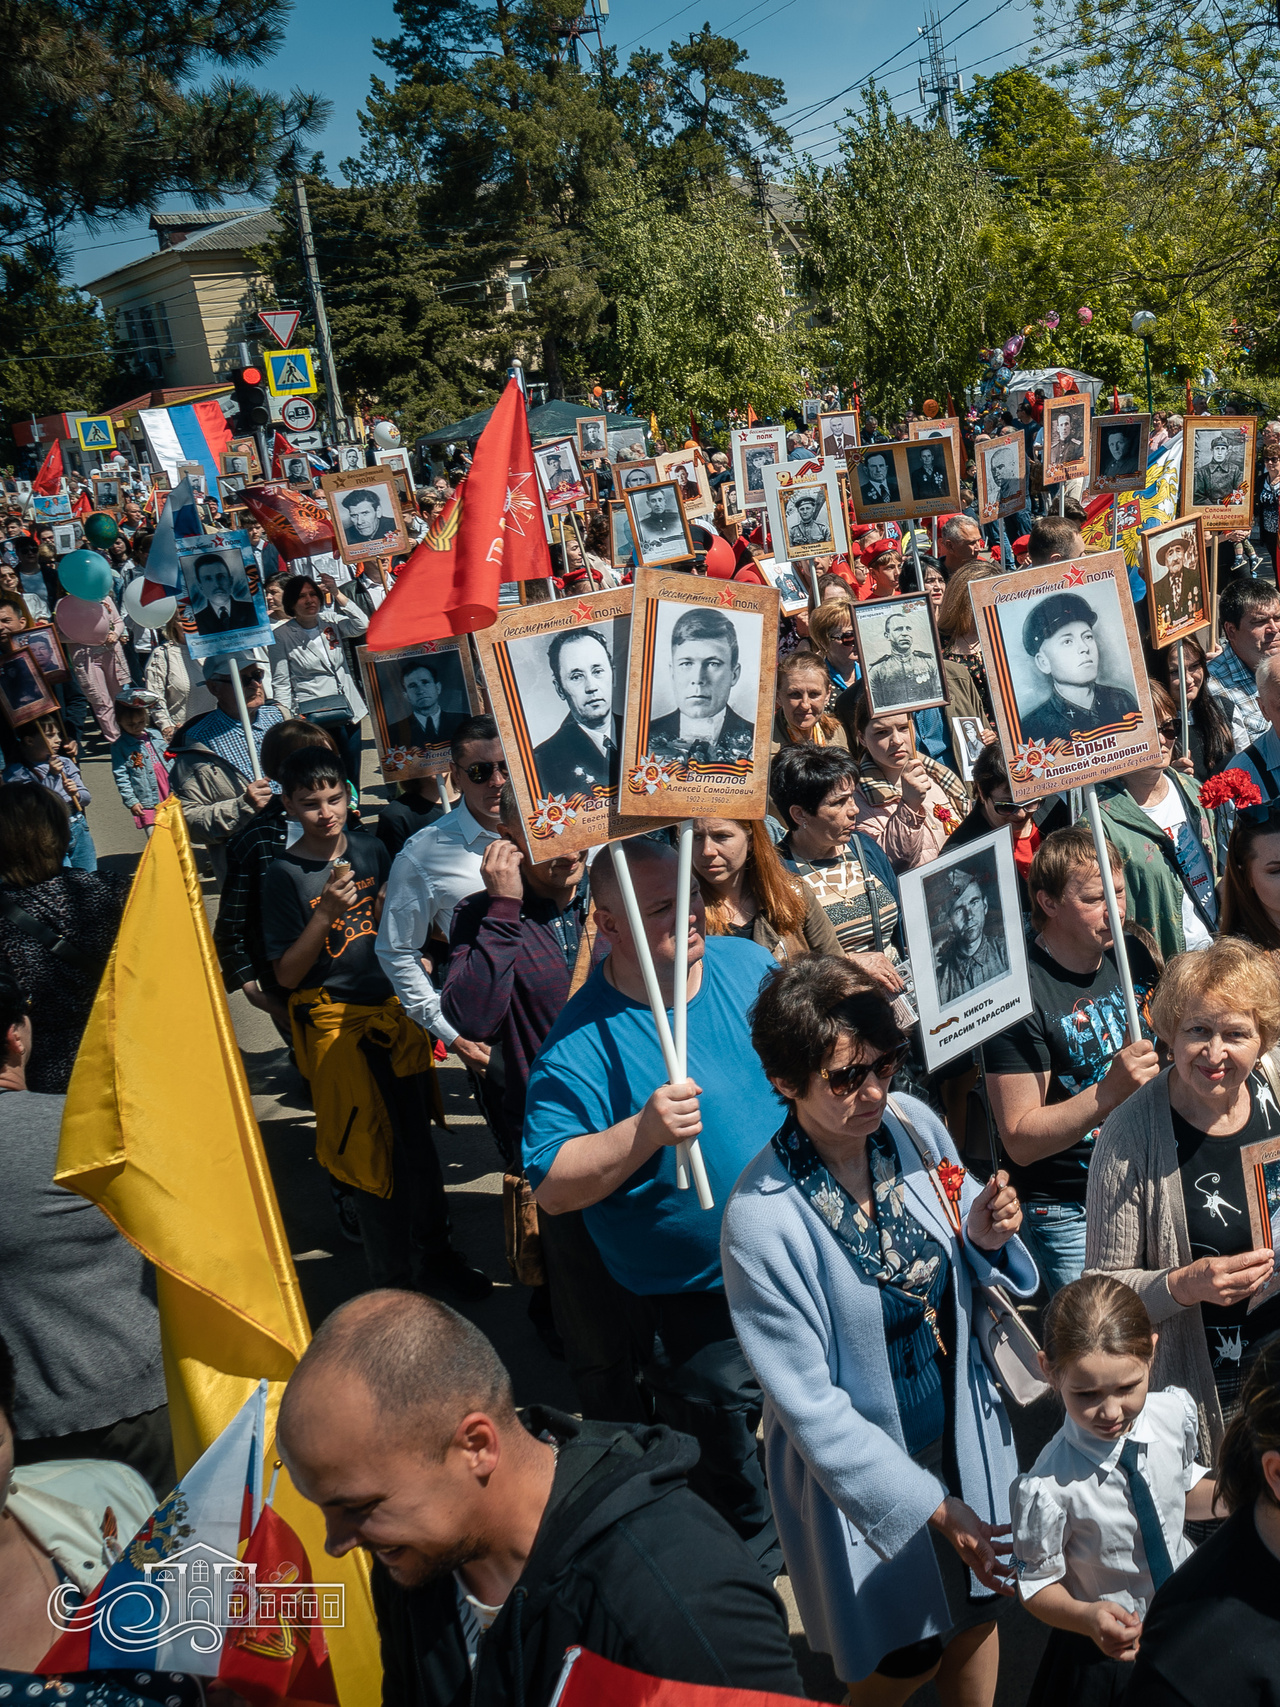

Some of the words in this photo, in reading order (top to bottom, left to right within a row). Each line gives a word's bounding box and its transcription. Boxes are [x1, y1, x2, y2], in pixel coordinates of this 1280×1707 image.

[356, 476, 377, 485] ПОЛК
[776, 471, 792, 487] 9
[792, 474, 817, 484] МАЯ
[658, 576, 719, 604] бессмертный
[735, 600, 759, 610] ПОЛК
[992, 579, 1065, 605] бессмертный
[1086, 569, 1114, 583] ПОЛК
[501, 612, 573, 637] бессмертный
[594, 605, 623, 618] ПОЛК
[438, 642, 460, 652] ПОЛК
[1073, 735, 1117, 758] Брык
[1045, 757, 1090, 779] Алексей
[1091, 742, 1149, 767] Федорович
[1100, 762, 1126, 776] пропал
[1127, 758, 1139, 768] без
[686, 771, 747, 785] Баталов
[666, 784, 701, 794] Алексей
[704, 785, 754, 796] Самойлович
[585, 796, 619, 812] Расс
[692, 806, 717, 815] рядовой
[601, 822, 649, 838] подполковник
[355, 877, 375, 890] TART
[963, 998, 994, 1019] КИКОТЬ
[938, 1022, 975, 1047] ГЕРАСИМ
[976, 997, 1021, 1027] ТАРАСОВИЧ
